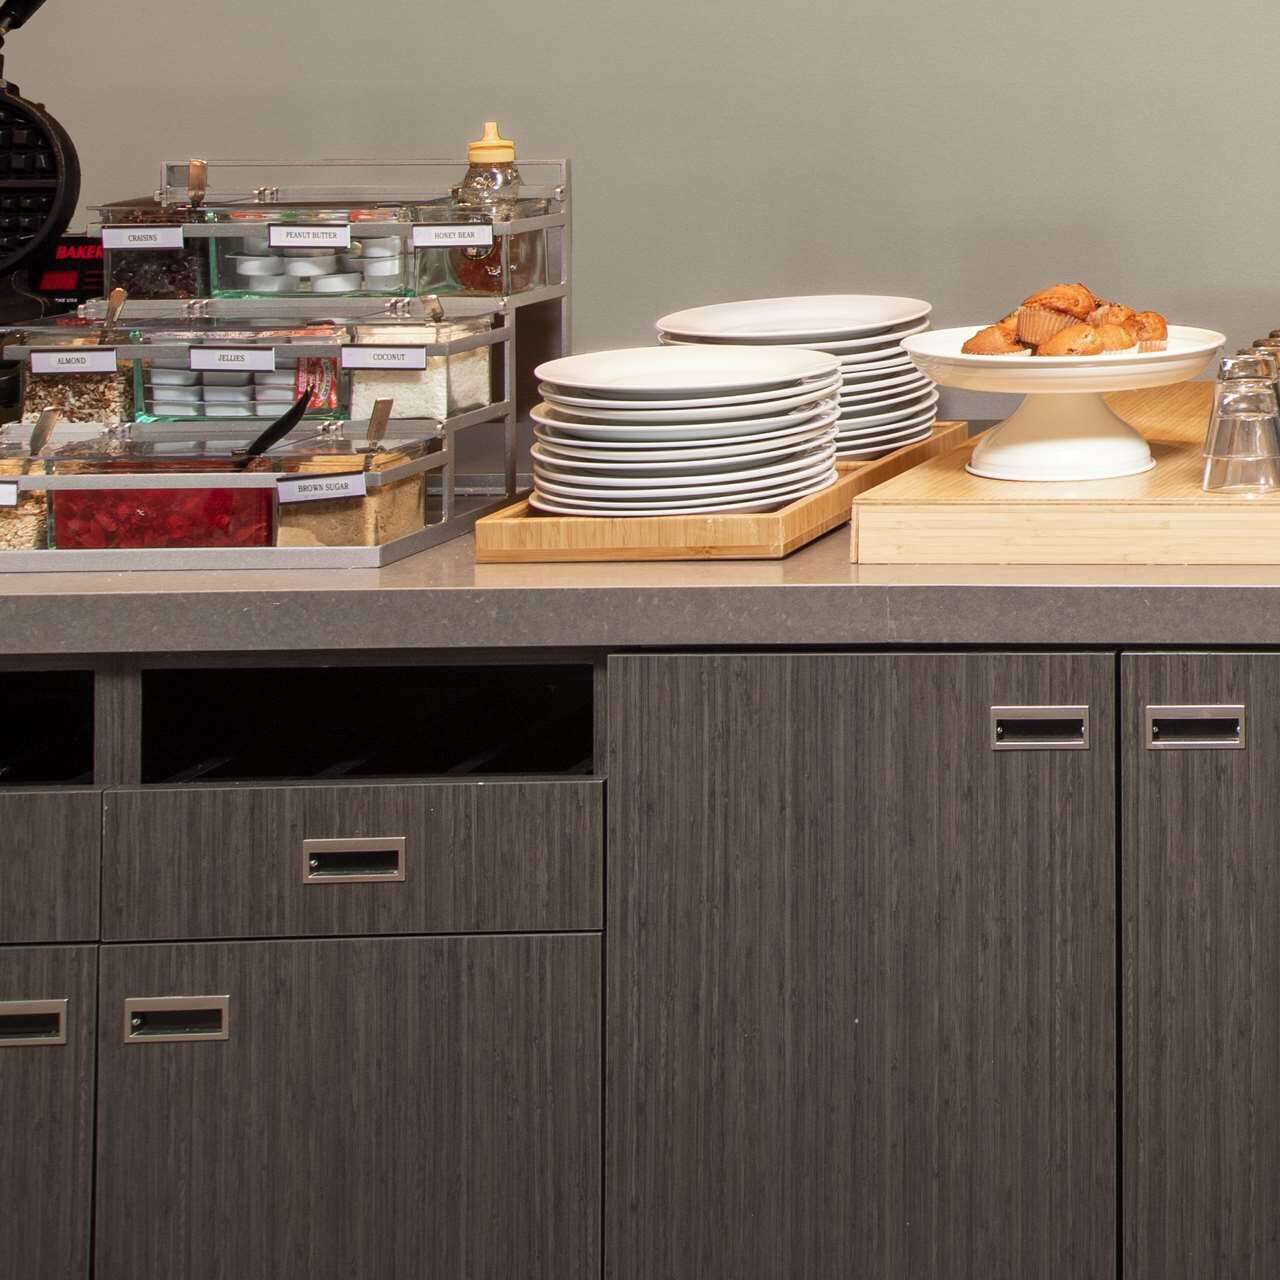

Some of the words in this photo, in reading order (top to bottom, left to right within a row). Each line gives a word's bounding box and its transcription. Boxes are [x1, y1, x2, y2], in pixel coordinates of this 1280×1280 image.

[286, 231, 310, 239] PEANUT
[458, 231, 475, 239] BEAR
[57, 357, 87, 365] ALMOND
[218, 354, 246, 362] JELLIES
[372, 353, 405, 361] COCONUT
[298, 484, 323, 492] BROWN
[325, 482, 349, 491] SUGAR
